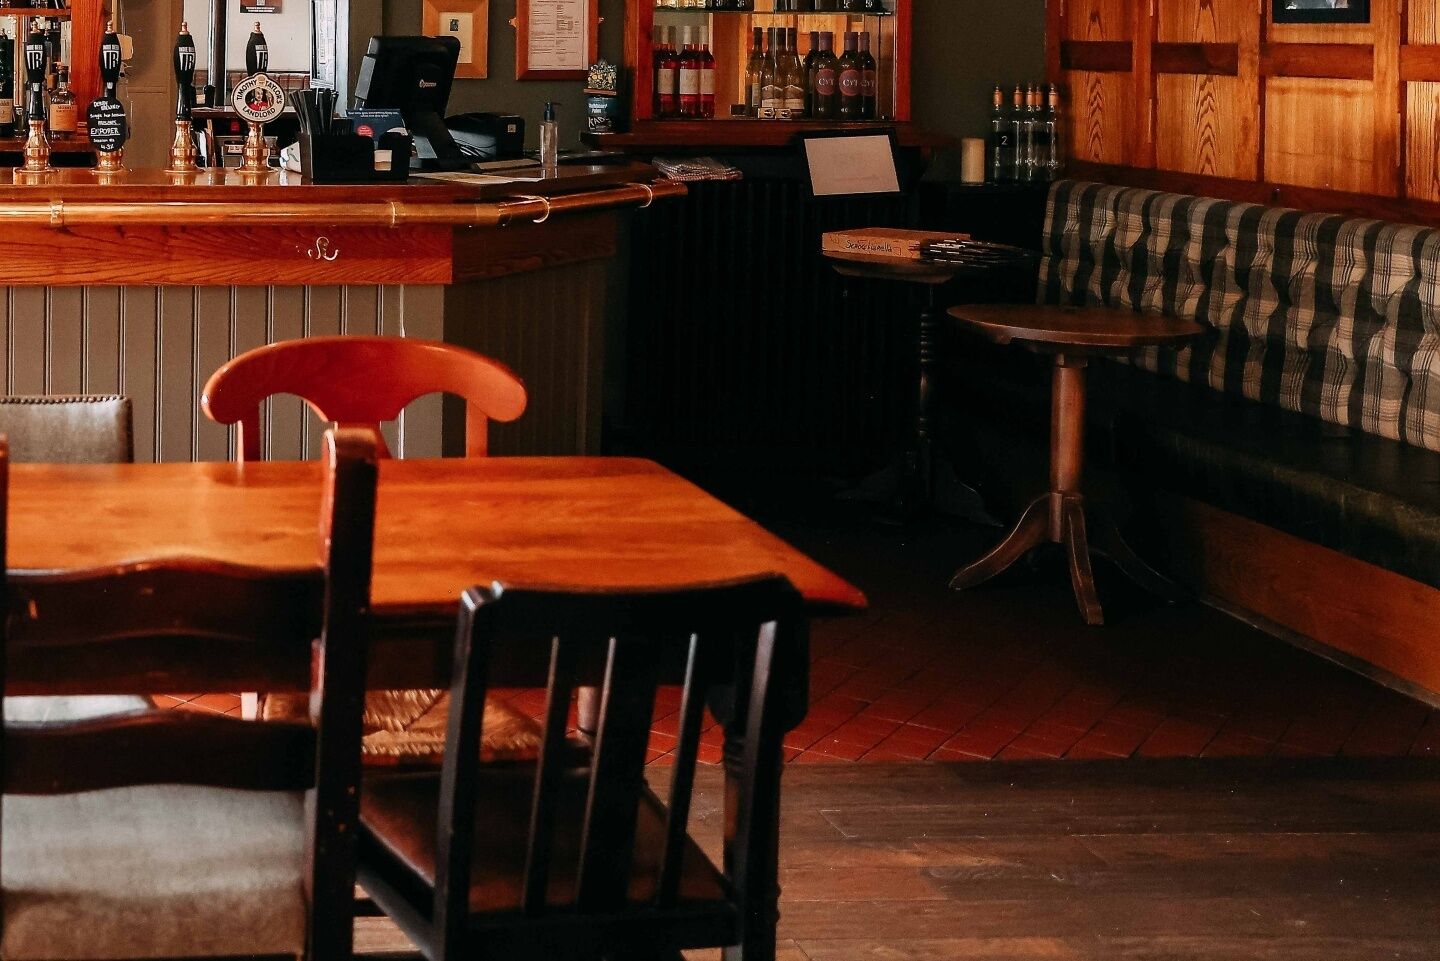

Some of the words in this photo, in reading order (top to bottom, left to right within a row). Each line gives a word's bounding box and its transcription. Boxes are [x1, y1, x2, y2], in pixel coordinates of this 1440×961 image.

[236, 79, 257, 101] TIMOTHY
[265, 80, 283, 105] TAYLOR'S
[242, 105, 276, 118] LANDLORD
[1001, 135, 1008, 146] 2
